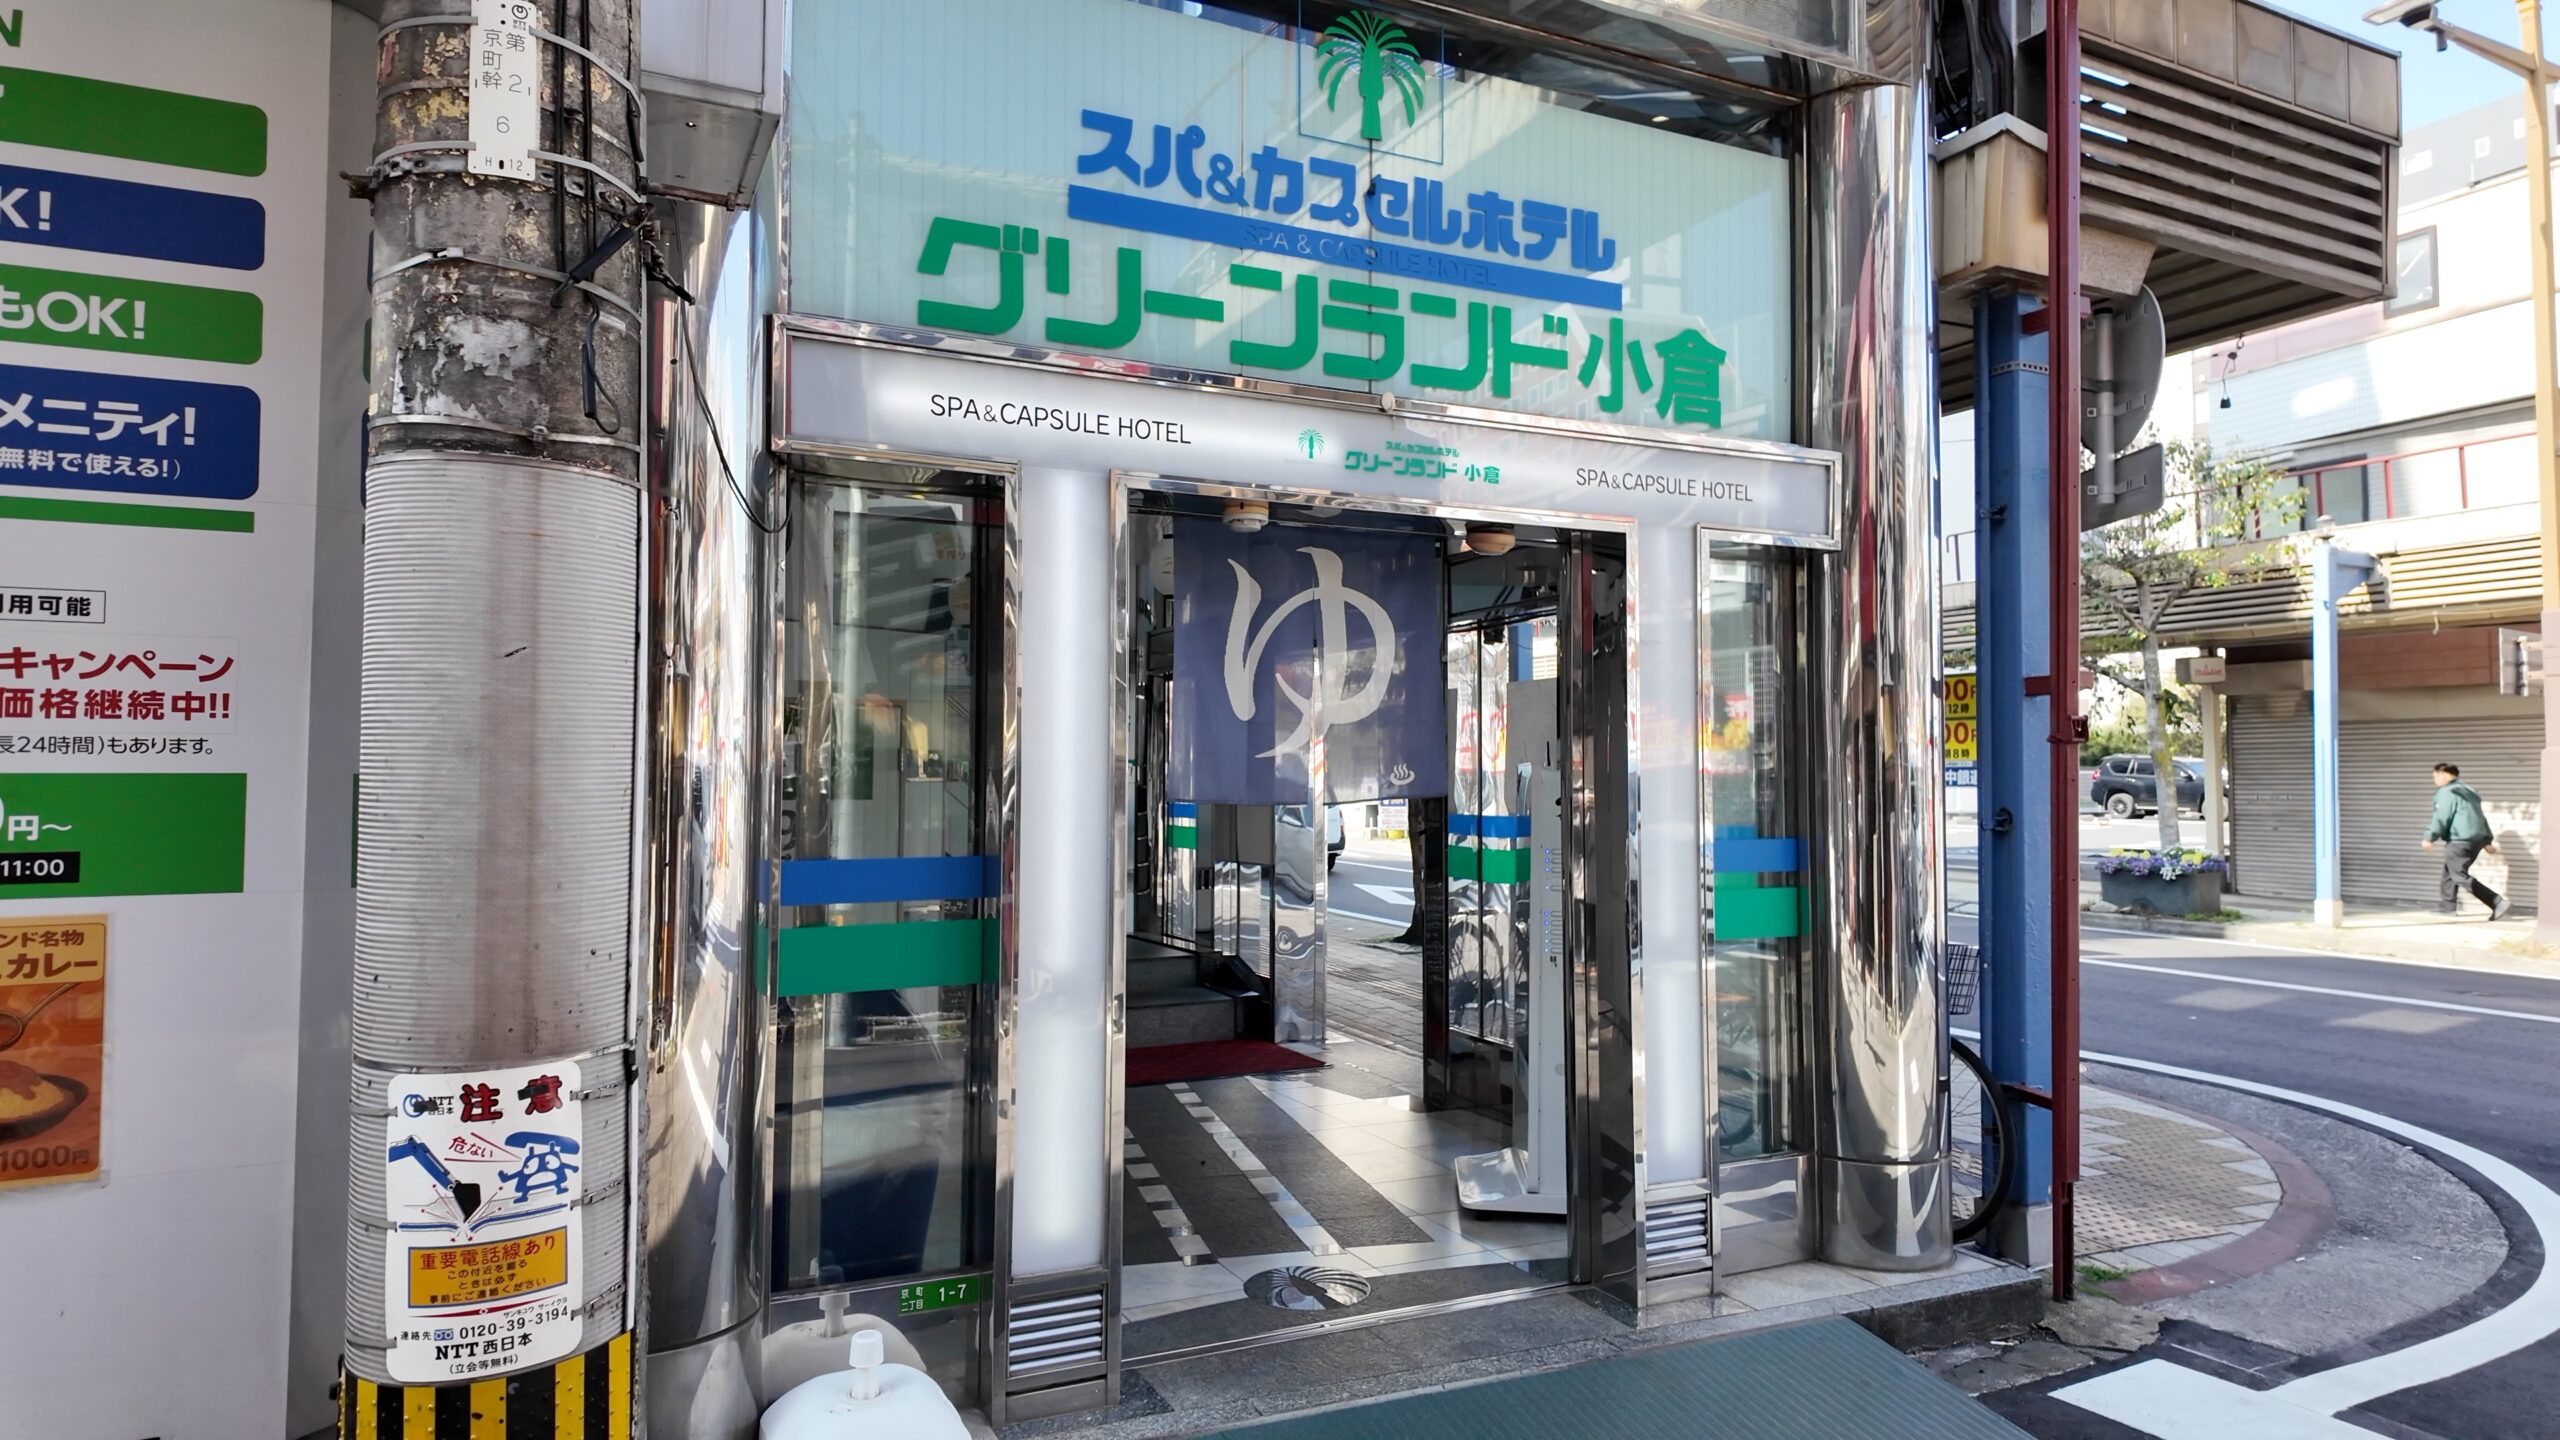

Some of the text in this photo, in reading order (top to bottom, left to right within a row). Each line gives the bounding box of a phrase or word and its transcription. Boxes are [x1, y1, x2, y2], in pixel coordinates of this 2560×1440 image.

[496, 115, 510, 134] 6
[1077, 108, 1616, 272] スパ&カプセルホテル
[1296, 234, 1313, 255] &
[1428, 256, 1497, 287] HOTEL
[0, 285, 146, 340] もOK!
[917, 216, 1728, 430] グリーンランド小倉
[0, 393, 196, 446] メニティ!
[930, 394, 1192, 444] SPA&CAPSULE HOTEL
[1576, 467, 1753, 502] SPA&CAPSULE HOTEL
[0, 593, 91, 618] 用可能
[0, 646, 234, 683] キャンペーン
[1224, 547, 1396, 758] ゆ
[0, 686, 231, 722] 価格継続中!!
[449, 1136, 493, 1158] 危ない
[420, 1235, 555, 1270] 重要電話線あり
[901, 1299, 924, 1312] 二丁目
[938, 1283, 967, 1302] 1-7
[459, 1305, 568, 1340] 0120-39-3194
